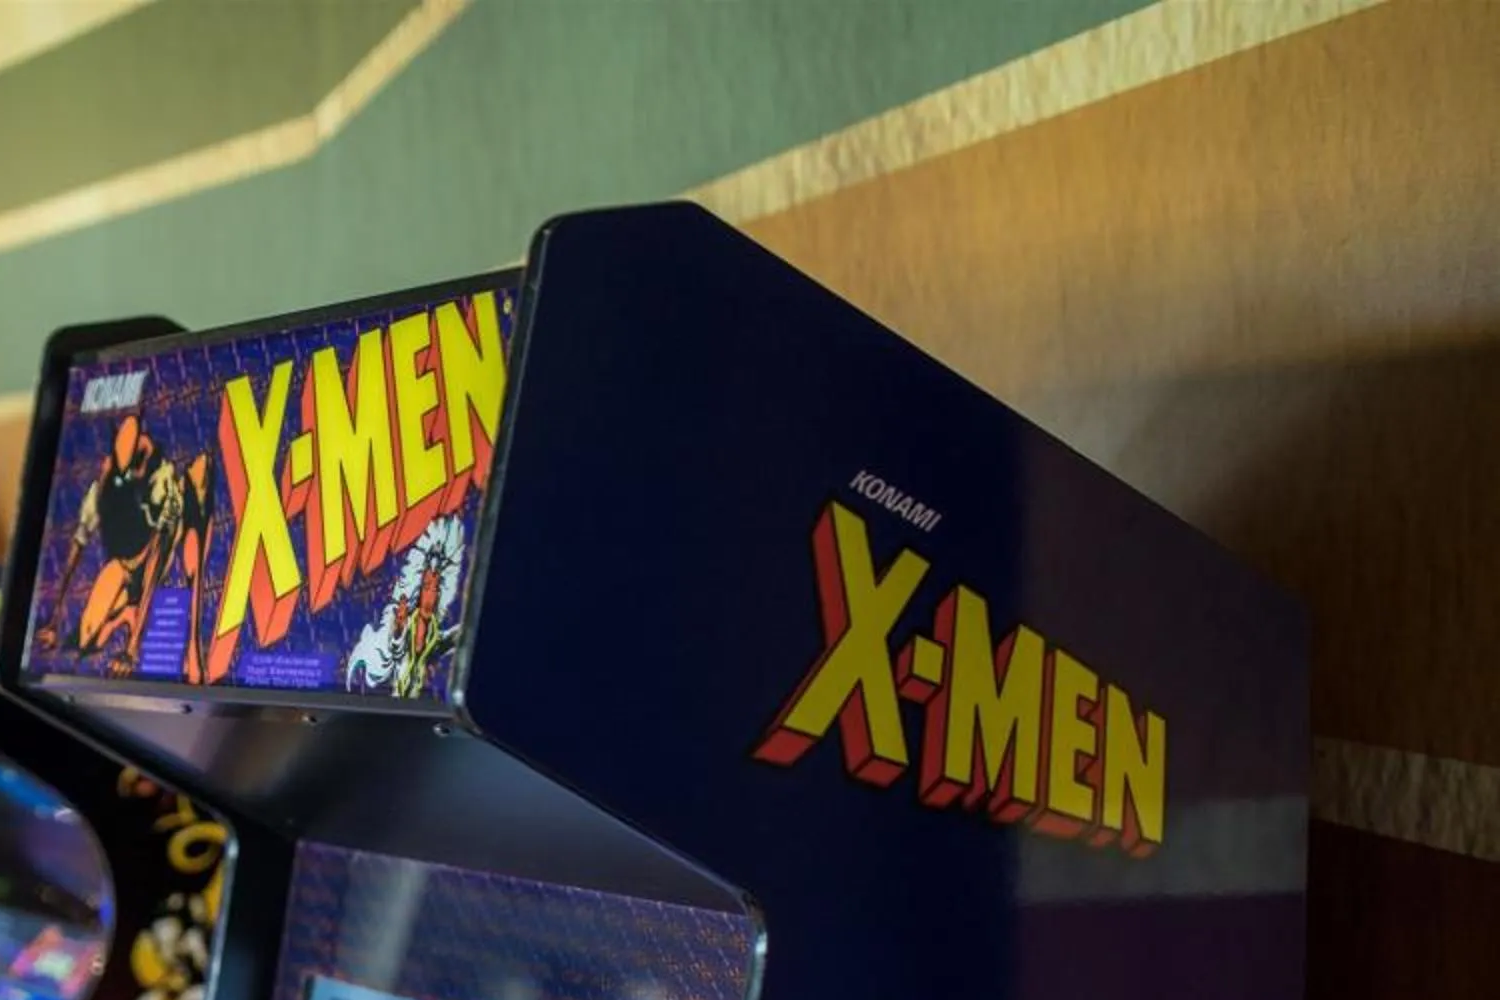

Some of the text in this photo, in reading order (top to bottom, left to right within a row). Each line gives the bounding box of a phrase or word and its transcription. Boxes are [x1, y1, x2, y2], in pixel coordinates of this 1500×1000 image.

[207, 290, 508, 684] X-MEN
[848, 470, 942, 532] KONAMI
[751, 500, 1167, 860] X-MEN
